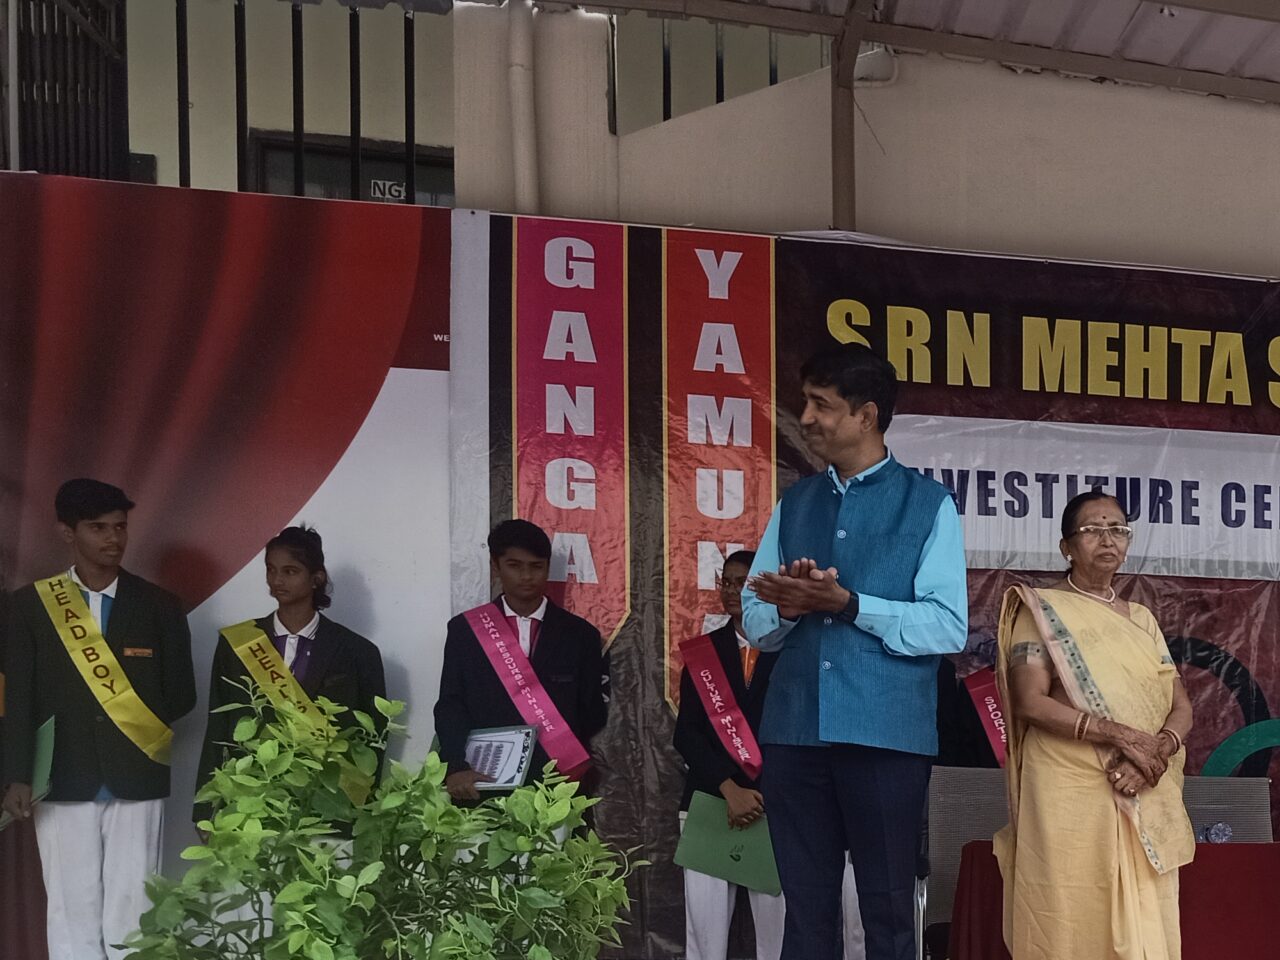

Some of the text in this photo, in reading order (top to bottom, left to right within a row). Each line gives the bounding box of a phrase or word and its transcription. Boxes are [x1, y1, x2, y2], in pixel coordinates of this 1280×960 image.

[543, 237, 599, 584] GANGA
[1022, 315, 1252, 407] MEHTA
[686, 248, 753, 635] YAMUN
[48, 579, 117, 695] HEAD BOY
[479, 612, 501, 640] HUMAN
[521, 686, 556, 733] MINISTER
[700, 669, 751, 761] CULTURAL MINISTER
